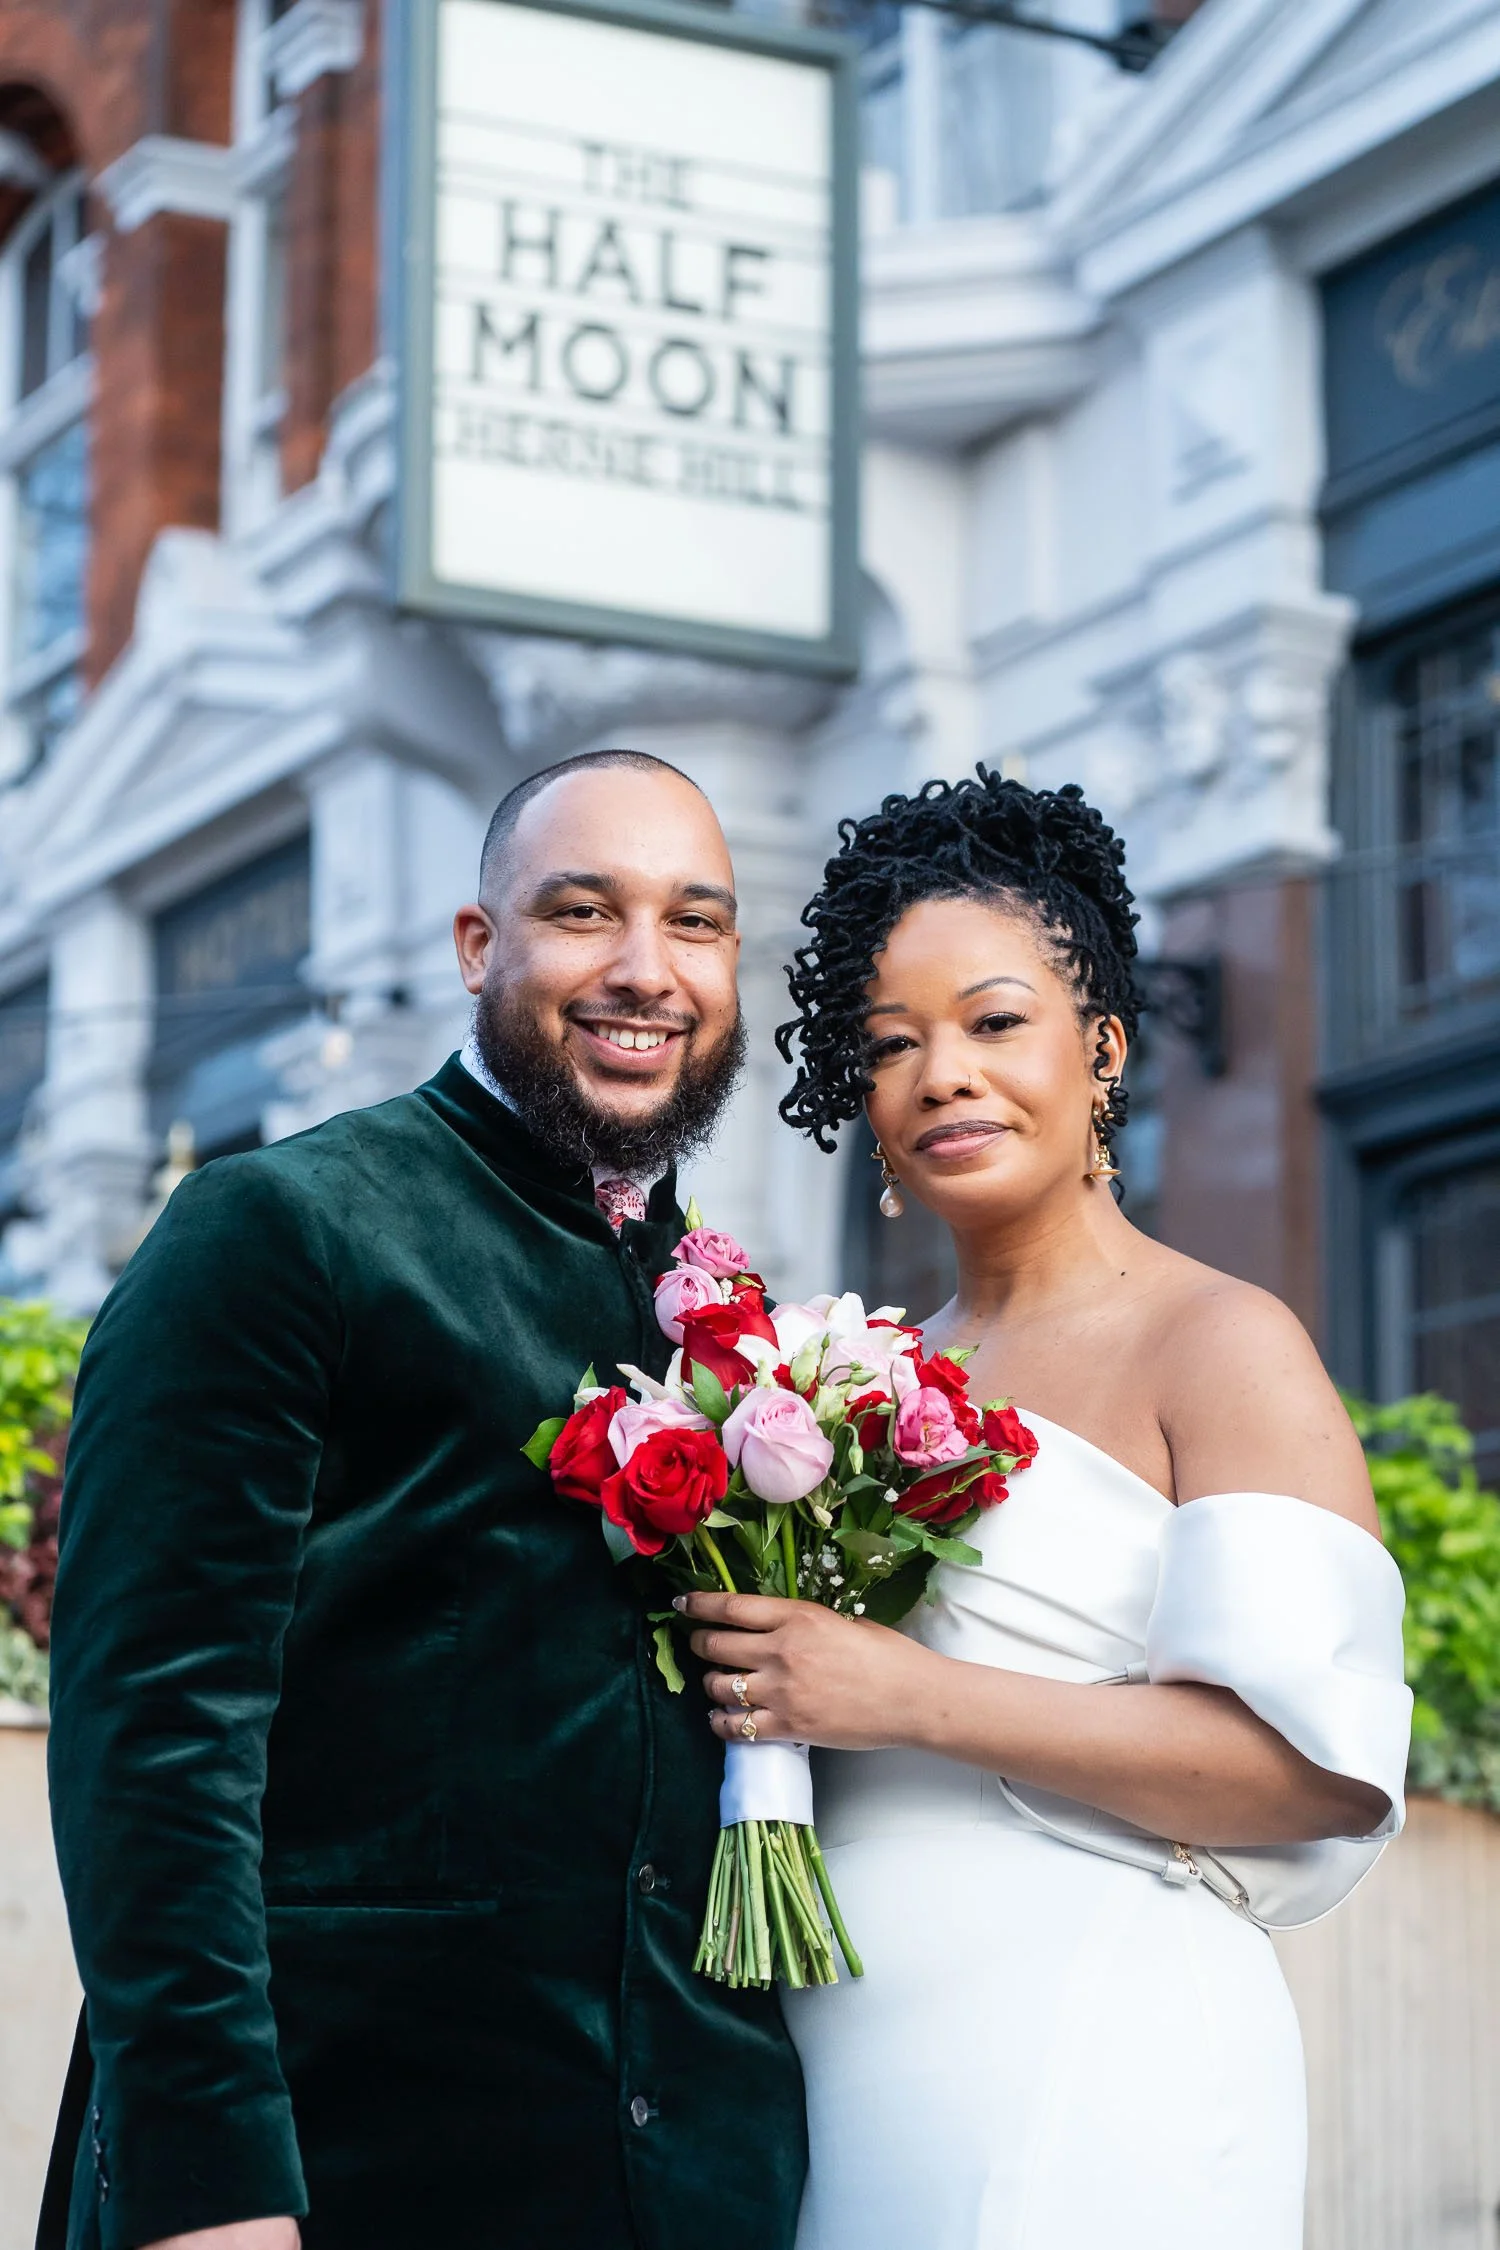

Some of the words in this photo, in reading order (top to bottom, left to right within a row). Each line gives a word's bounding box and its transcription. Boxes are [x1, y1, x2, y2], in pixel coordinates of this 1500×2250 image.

[578, 139, 694, 213] THE
[500, 201, 771, 321] HALF
[471, 303, 796, 437] MOON
